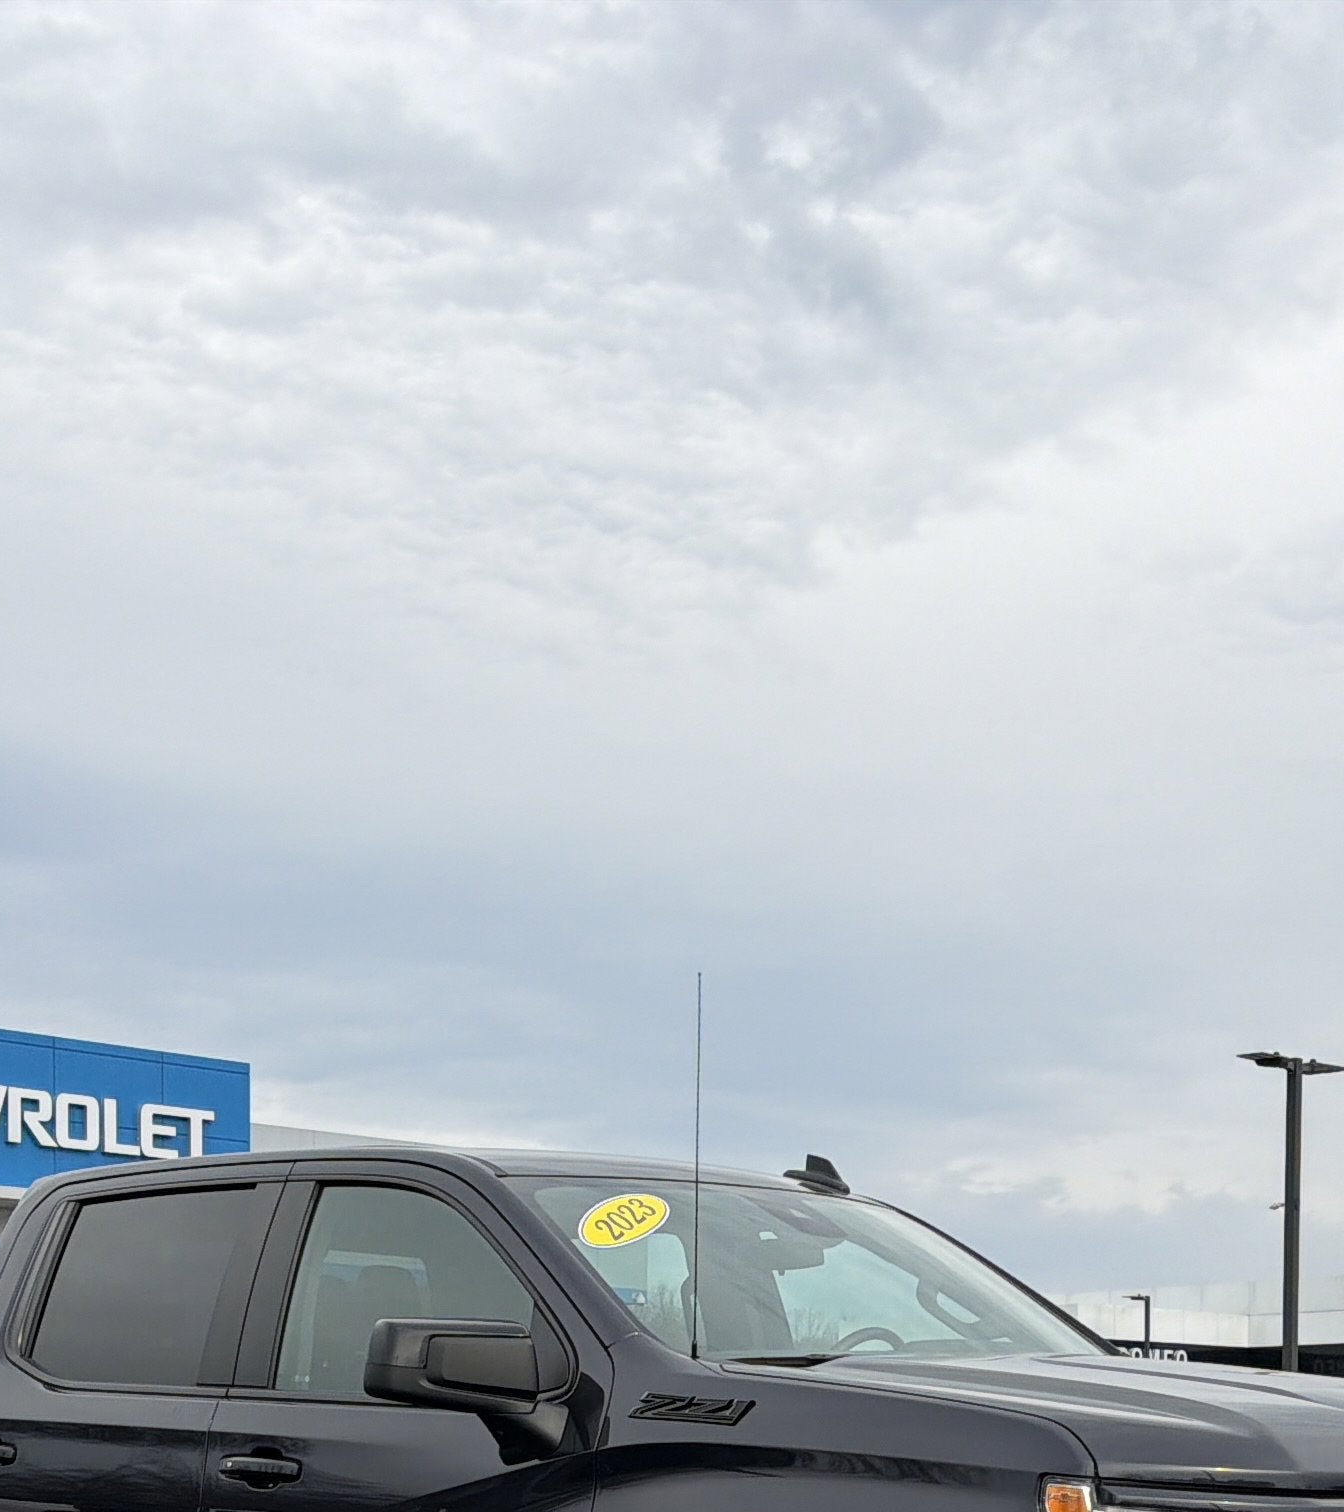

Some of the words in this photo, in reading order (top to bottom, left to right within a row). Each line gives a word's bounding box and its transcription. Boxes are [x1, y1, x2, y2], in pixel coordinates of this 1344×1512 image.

[595, 1198, 656, 1241] 2023
[1118, 1347, 1188, 1362] OMEO
[628, 1391, 756, 1426] Z71
